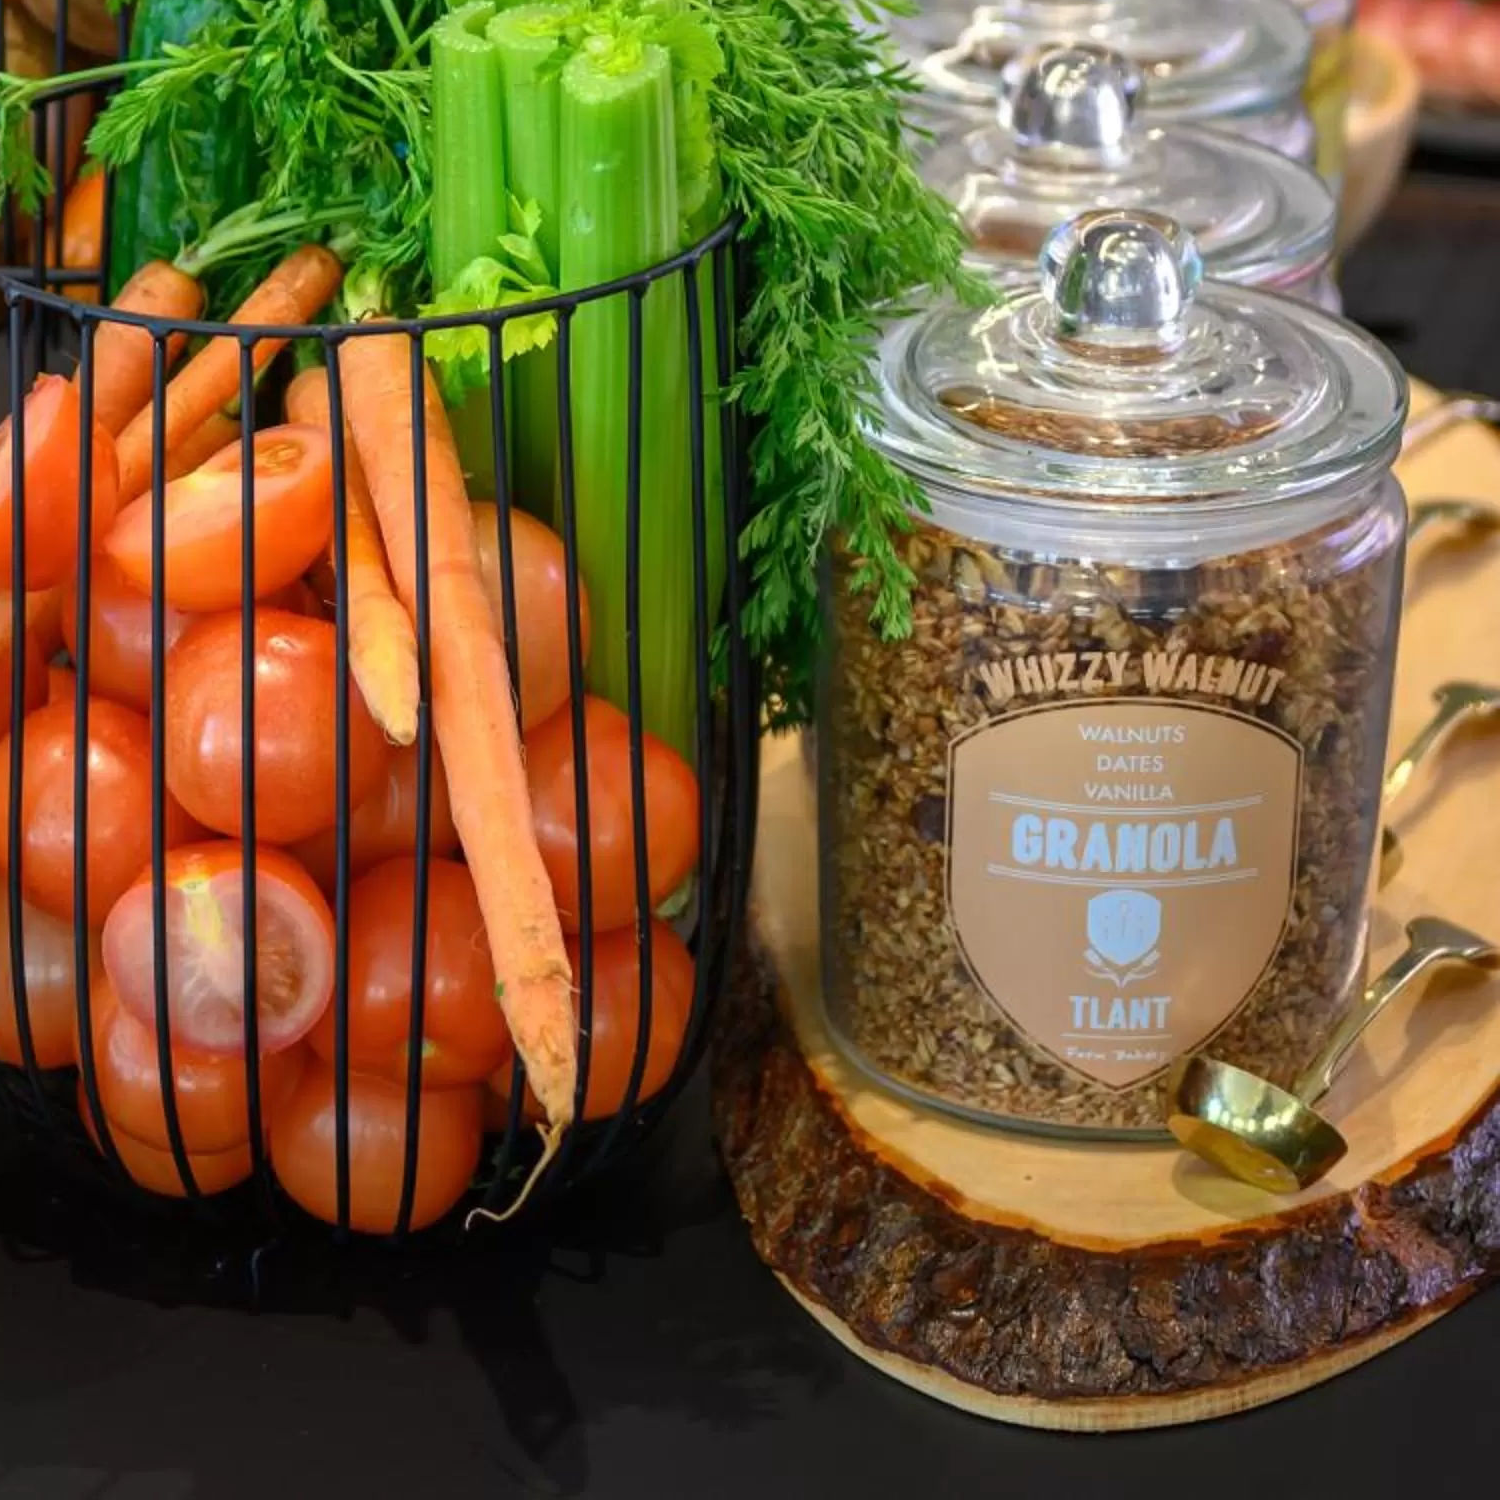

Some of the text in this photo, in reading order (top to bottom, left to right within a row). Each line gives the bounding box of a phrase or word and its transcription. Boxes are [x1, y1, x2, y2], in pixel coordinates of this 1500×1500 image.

[980, 651, 1286, 705] WHIZZY WALNUT
[1078, 723, 1186, 744] WALNUTS
[1096, 755, 1164, 773] DATES
[1084, 782, 1174, 801] VANILLA
[1011, 813, 1238, 873] GRANOLA
[1069, 996, 1171, 1030] TLANT
